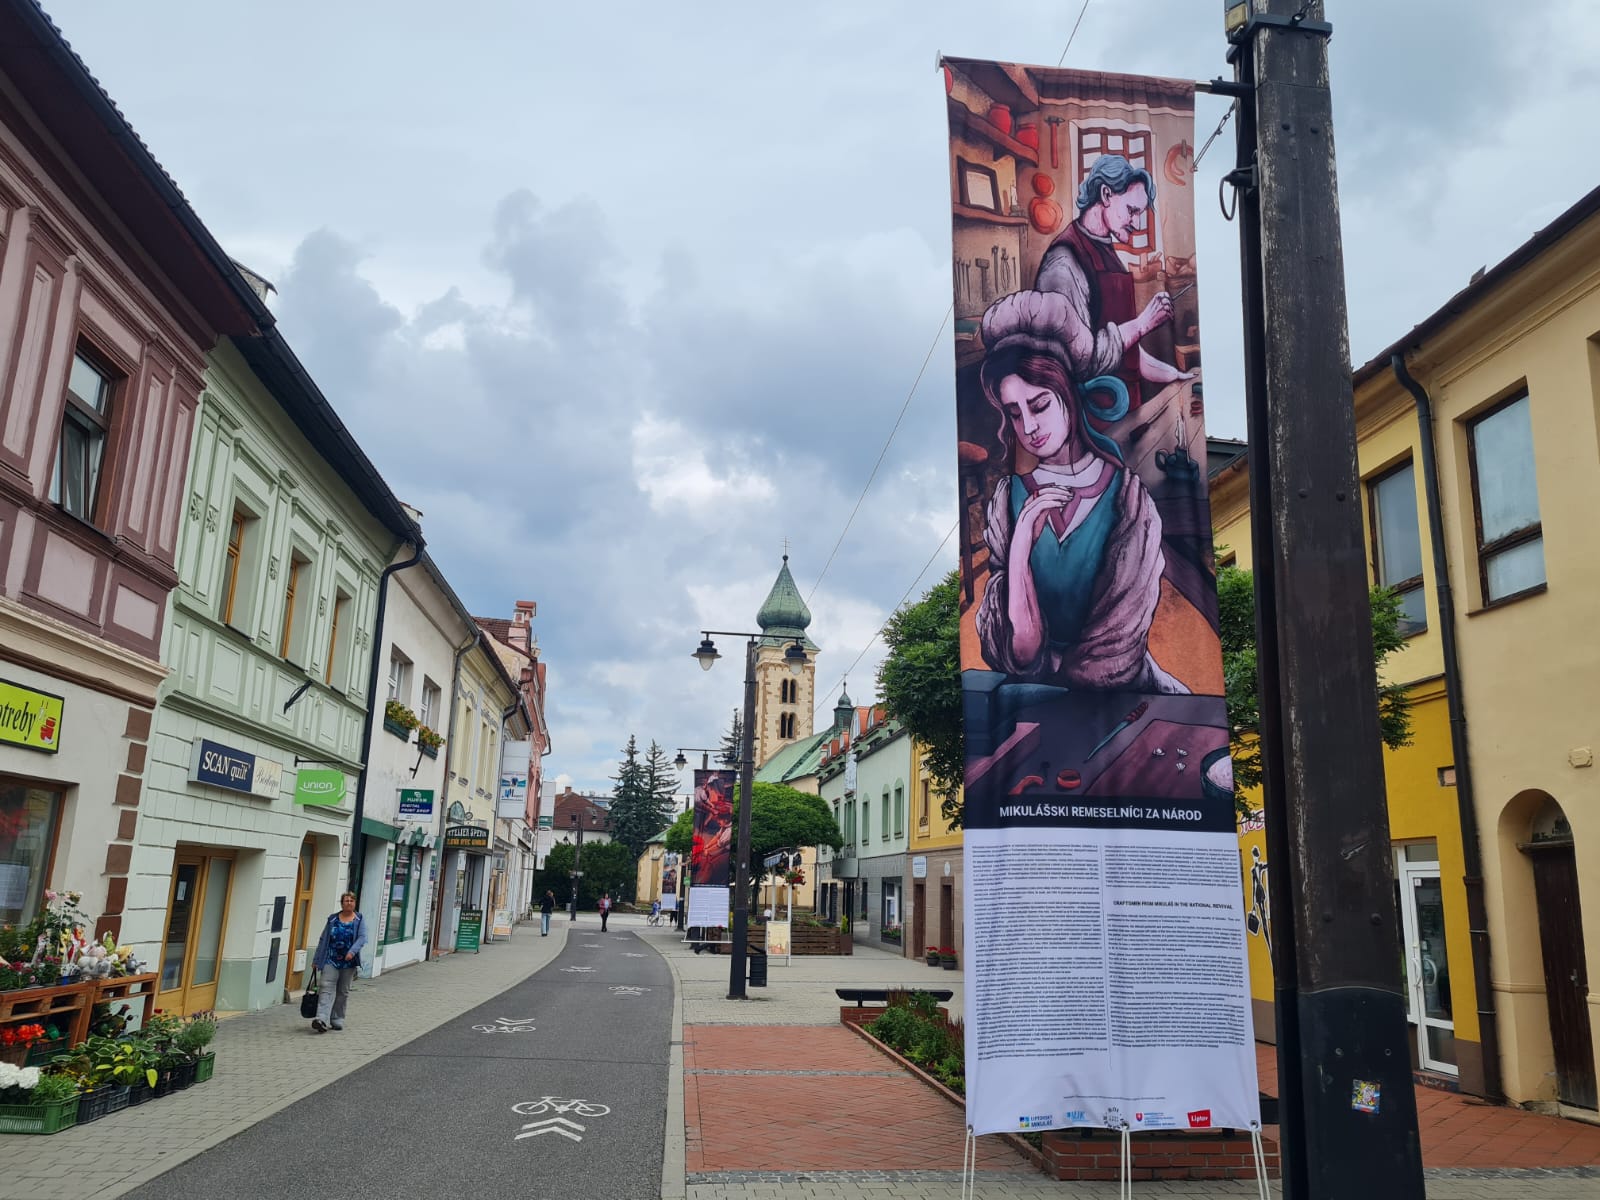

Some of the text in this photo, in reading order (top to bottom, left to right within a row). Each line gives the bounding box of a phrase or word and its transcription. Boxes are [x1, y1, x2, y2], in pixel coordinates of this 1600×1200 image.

[202, 751, 230, 775] SCAN
[230, 764, 248, 781] quilt
[303, 781, 333, 789] union
[999, 803, 1203, 821] MIKULÁŠSKI REMESELNÍCI ZA NÁROD
[1191, 1115, 1208, 1123] Liptov
